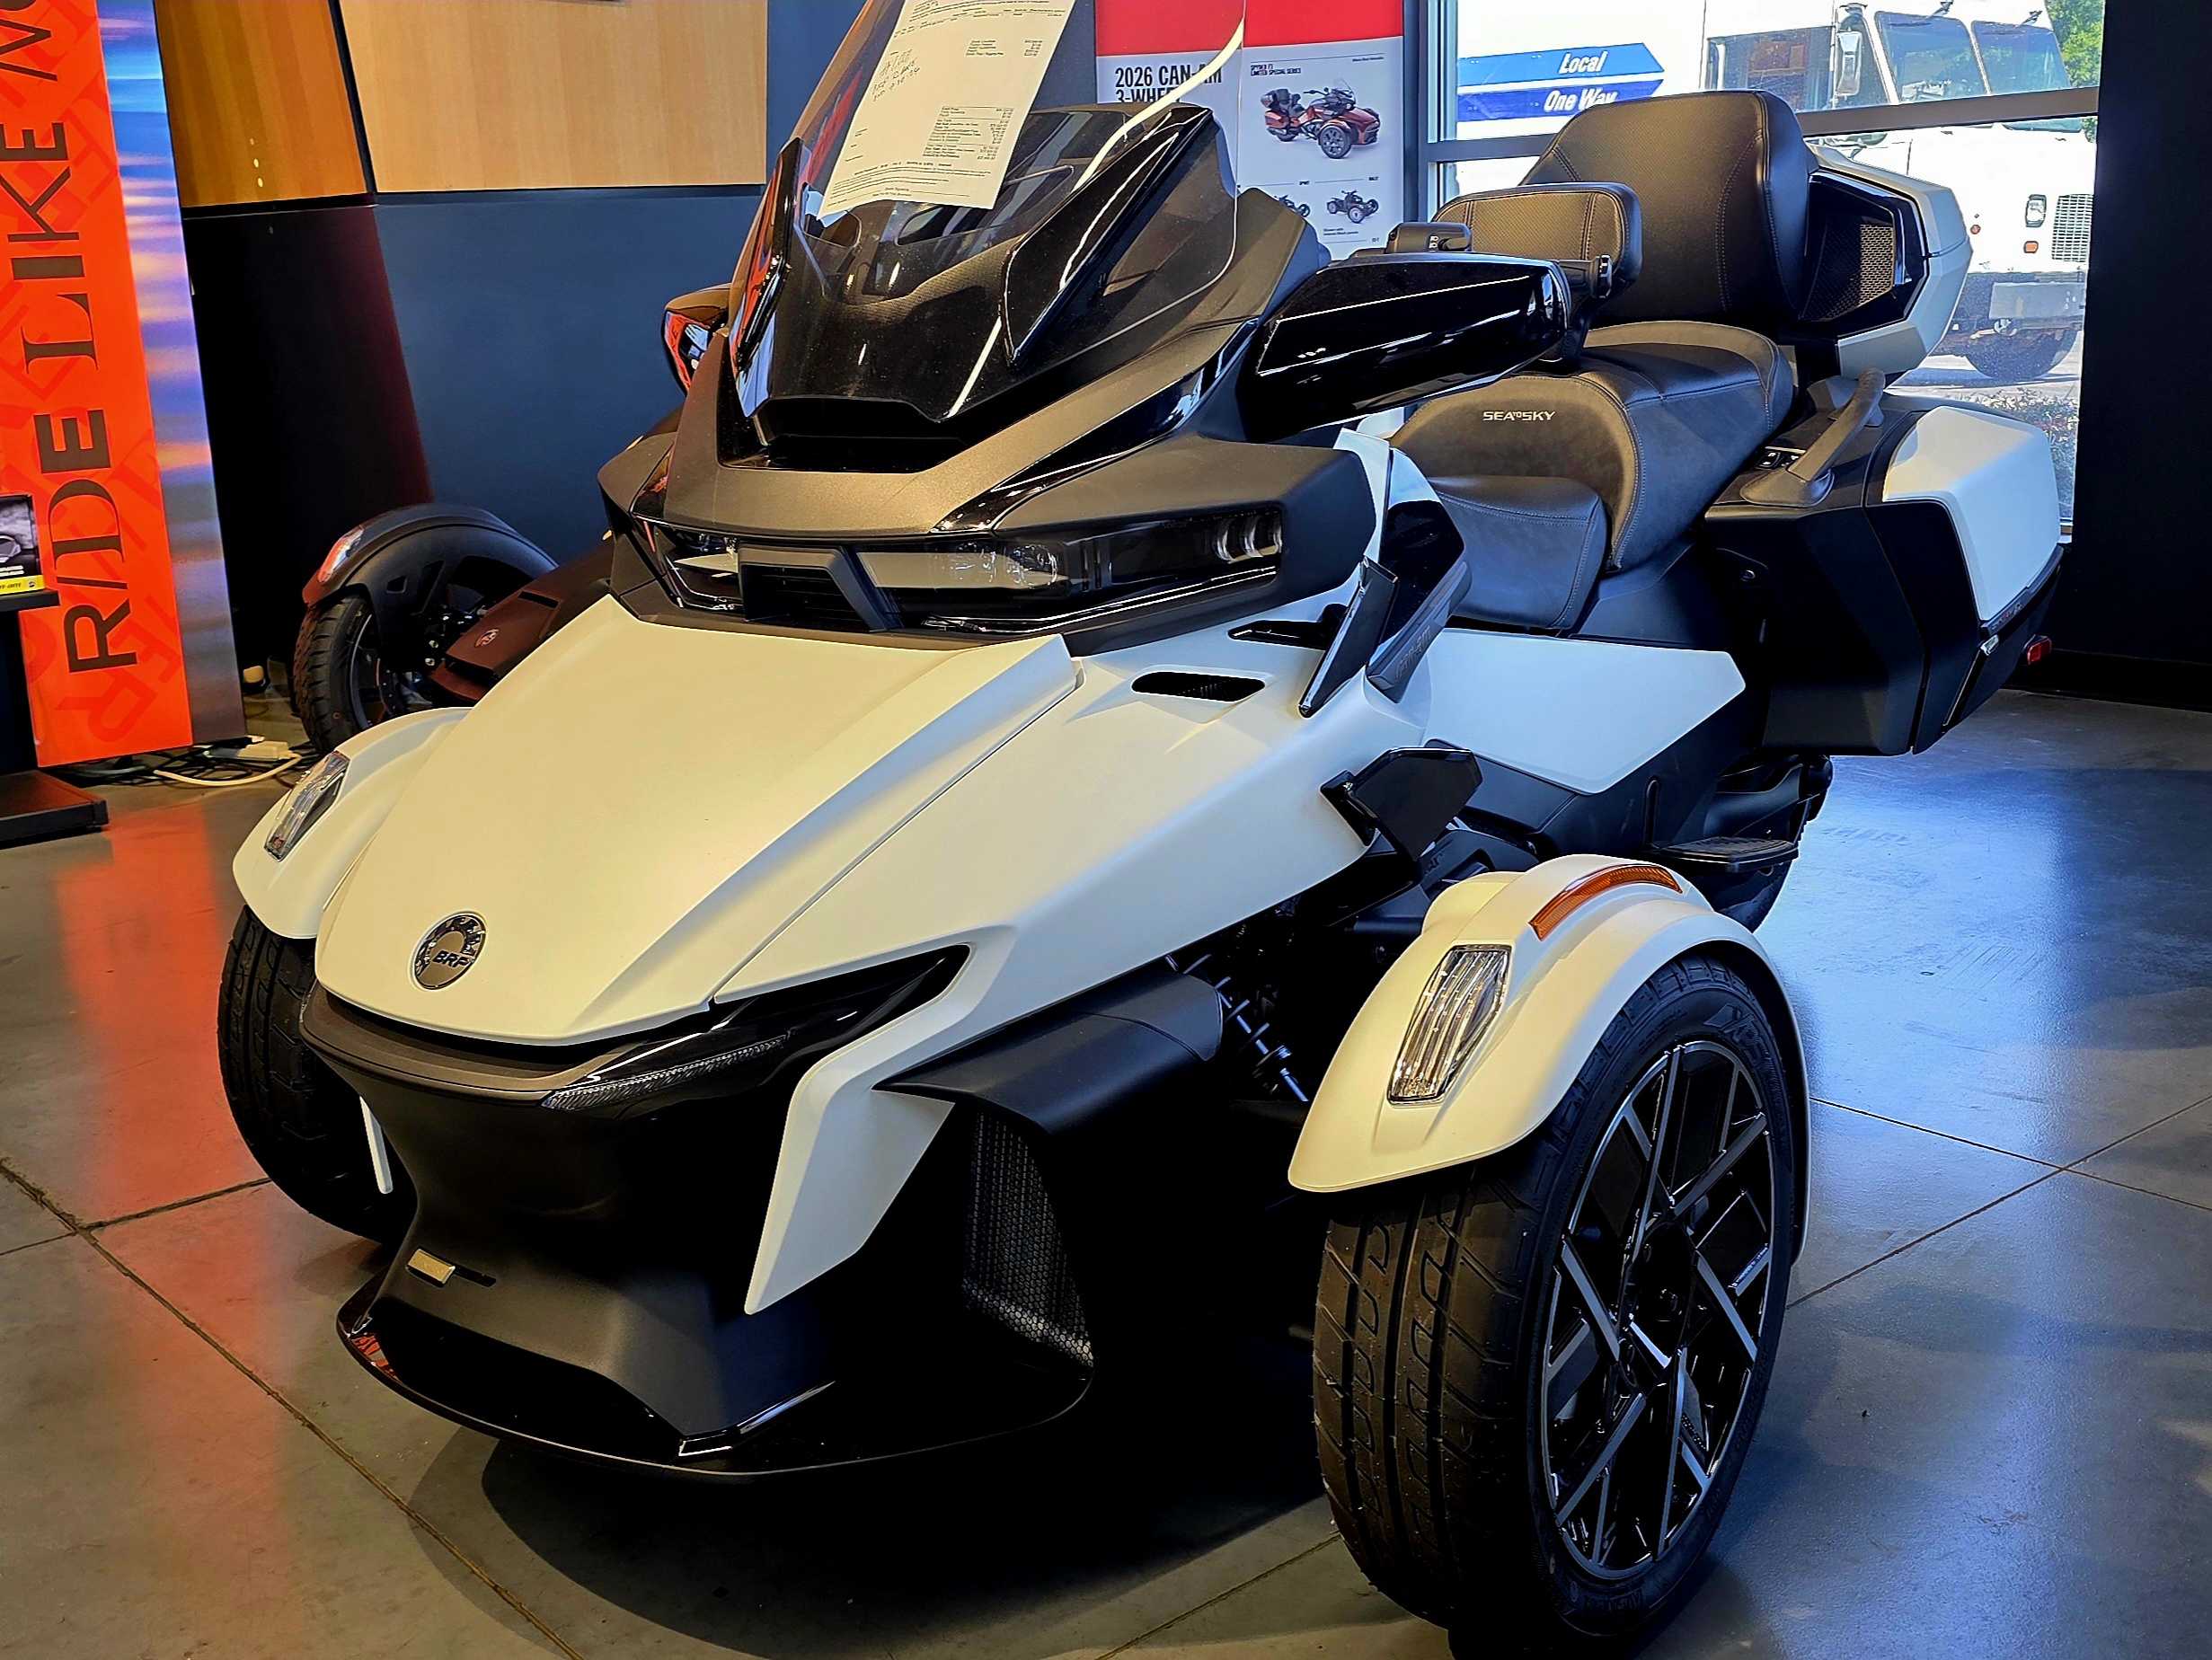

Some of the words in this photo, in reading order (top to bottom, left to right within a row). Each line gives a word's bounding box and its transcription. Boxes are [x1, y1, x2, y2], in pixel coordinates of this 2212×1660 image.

[0, 0, 58, 82] N
[1558, 50, 1609, 75] Local
[1115, 66, 1153, 88] 2026
[1544, 90, 1579, 113] One
[0, 121, 98, 374] LIKE
[33, 409, 138, 674] RIDE
[431, 949, 474, 968] BRP
